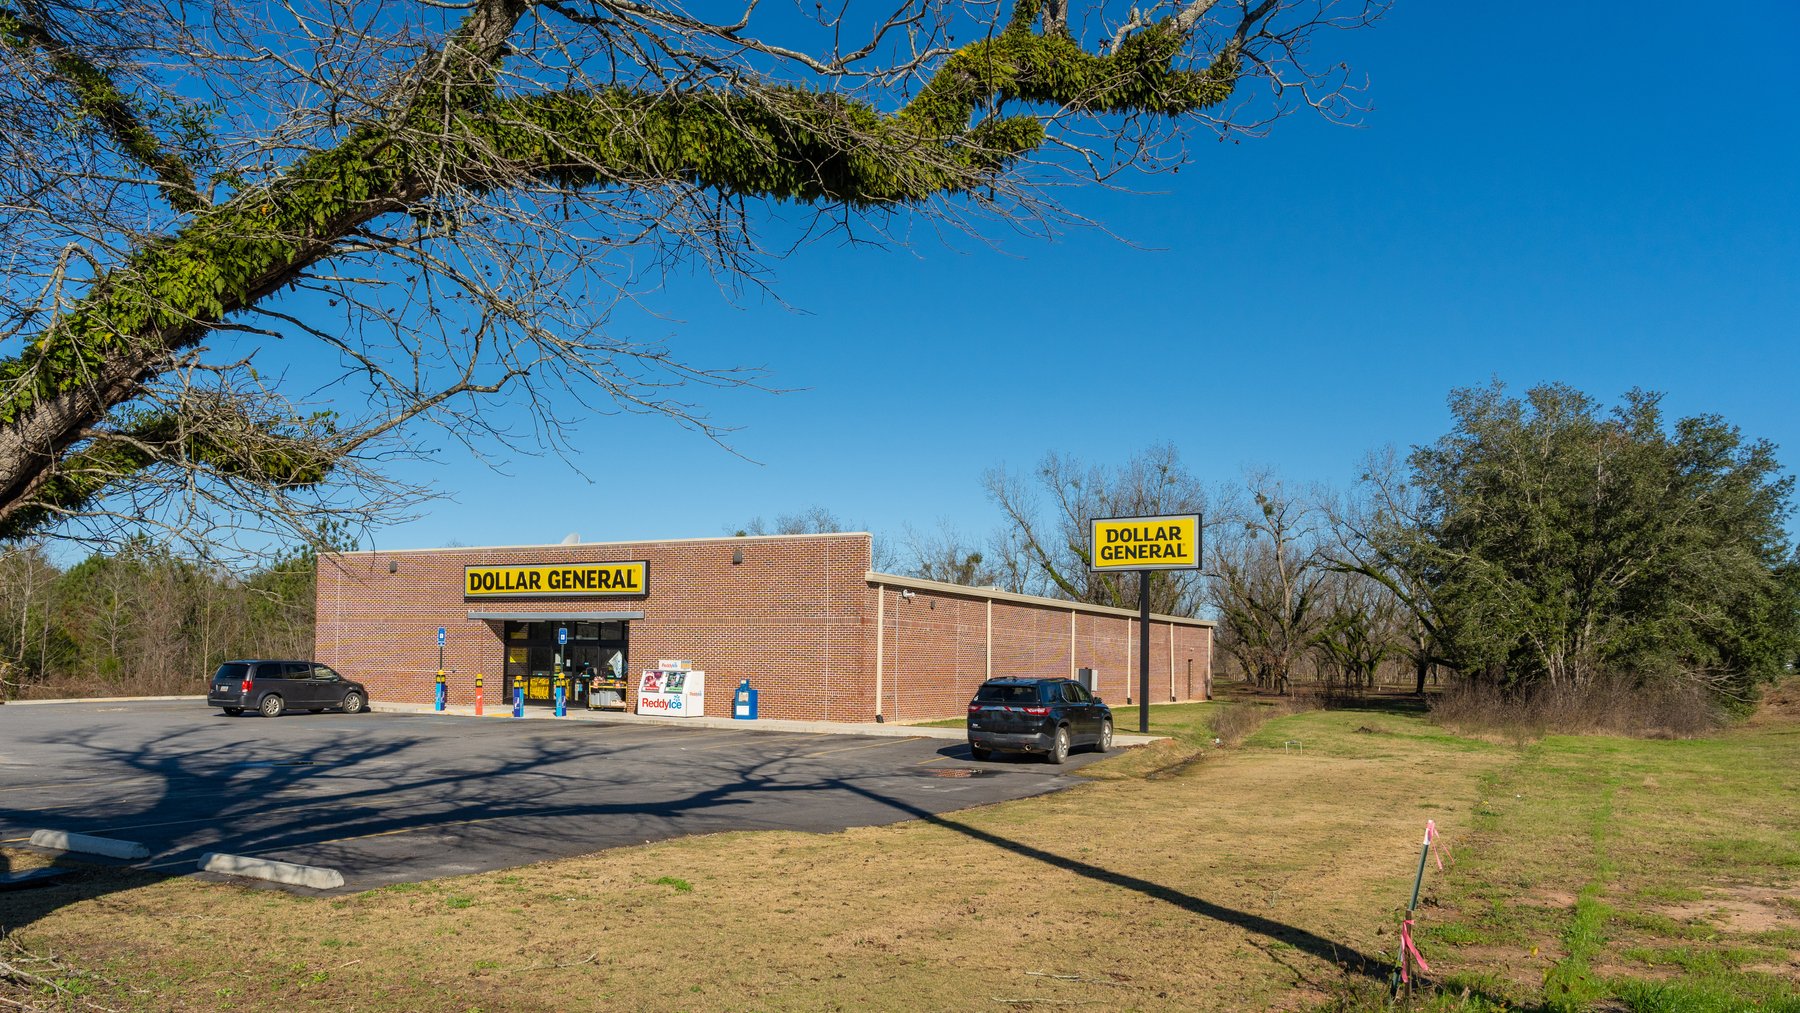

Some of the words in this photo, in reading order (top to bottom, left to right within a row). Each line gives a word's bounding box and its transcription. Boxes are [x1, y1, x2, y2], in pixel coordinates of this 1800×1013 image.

[1106, 526, 1182, 543] DOLLAR
[1100, 543, 1187, 560] GENERAL
[469, 571, 541, 591] DOLLAR
[547, 569, 638, 590] GENERAL
